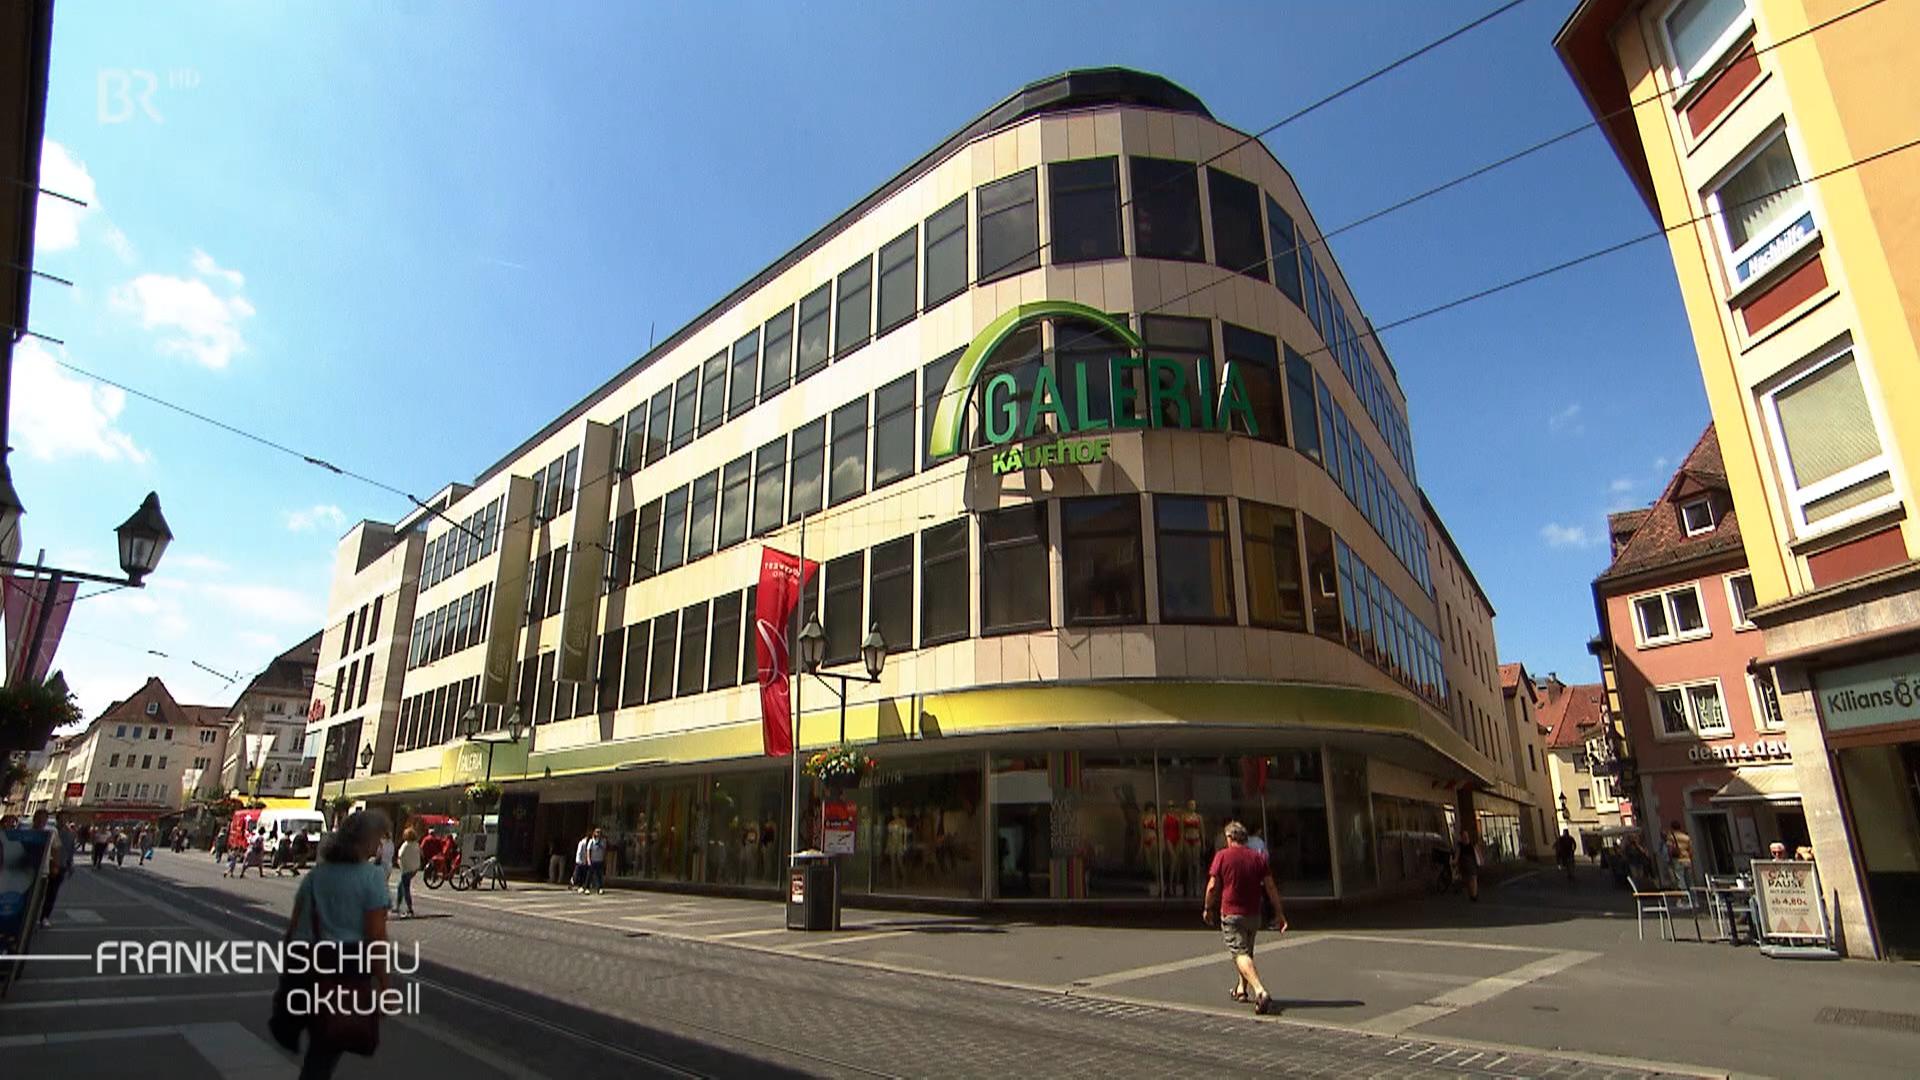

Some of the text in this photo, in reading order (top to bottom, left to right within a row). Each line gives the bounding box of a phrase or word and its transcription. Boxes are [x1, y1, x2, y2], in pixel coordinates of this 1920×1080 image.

[985, 357, 1260, 444] GALERIA
[1688, 744, 1735, 760] dean
[1738, 742, 1751, 757] &
